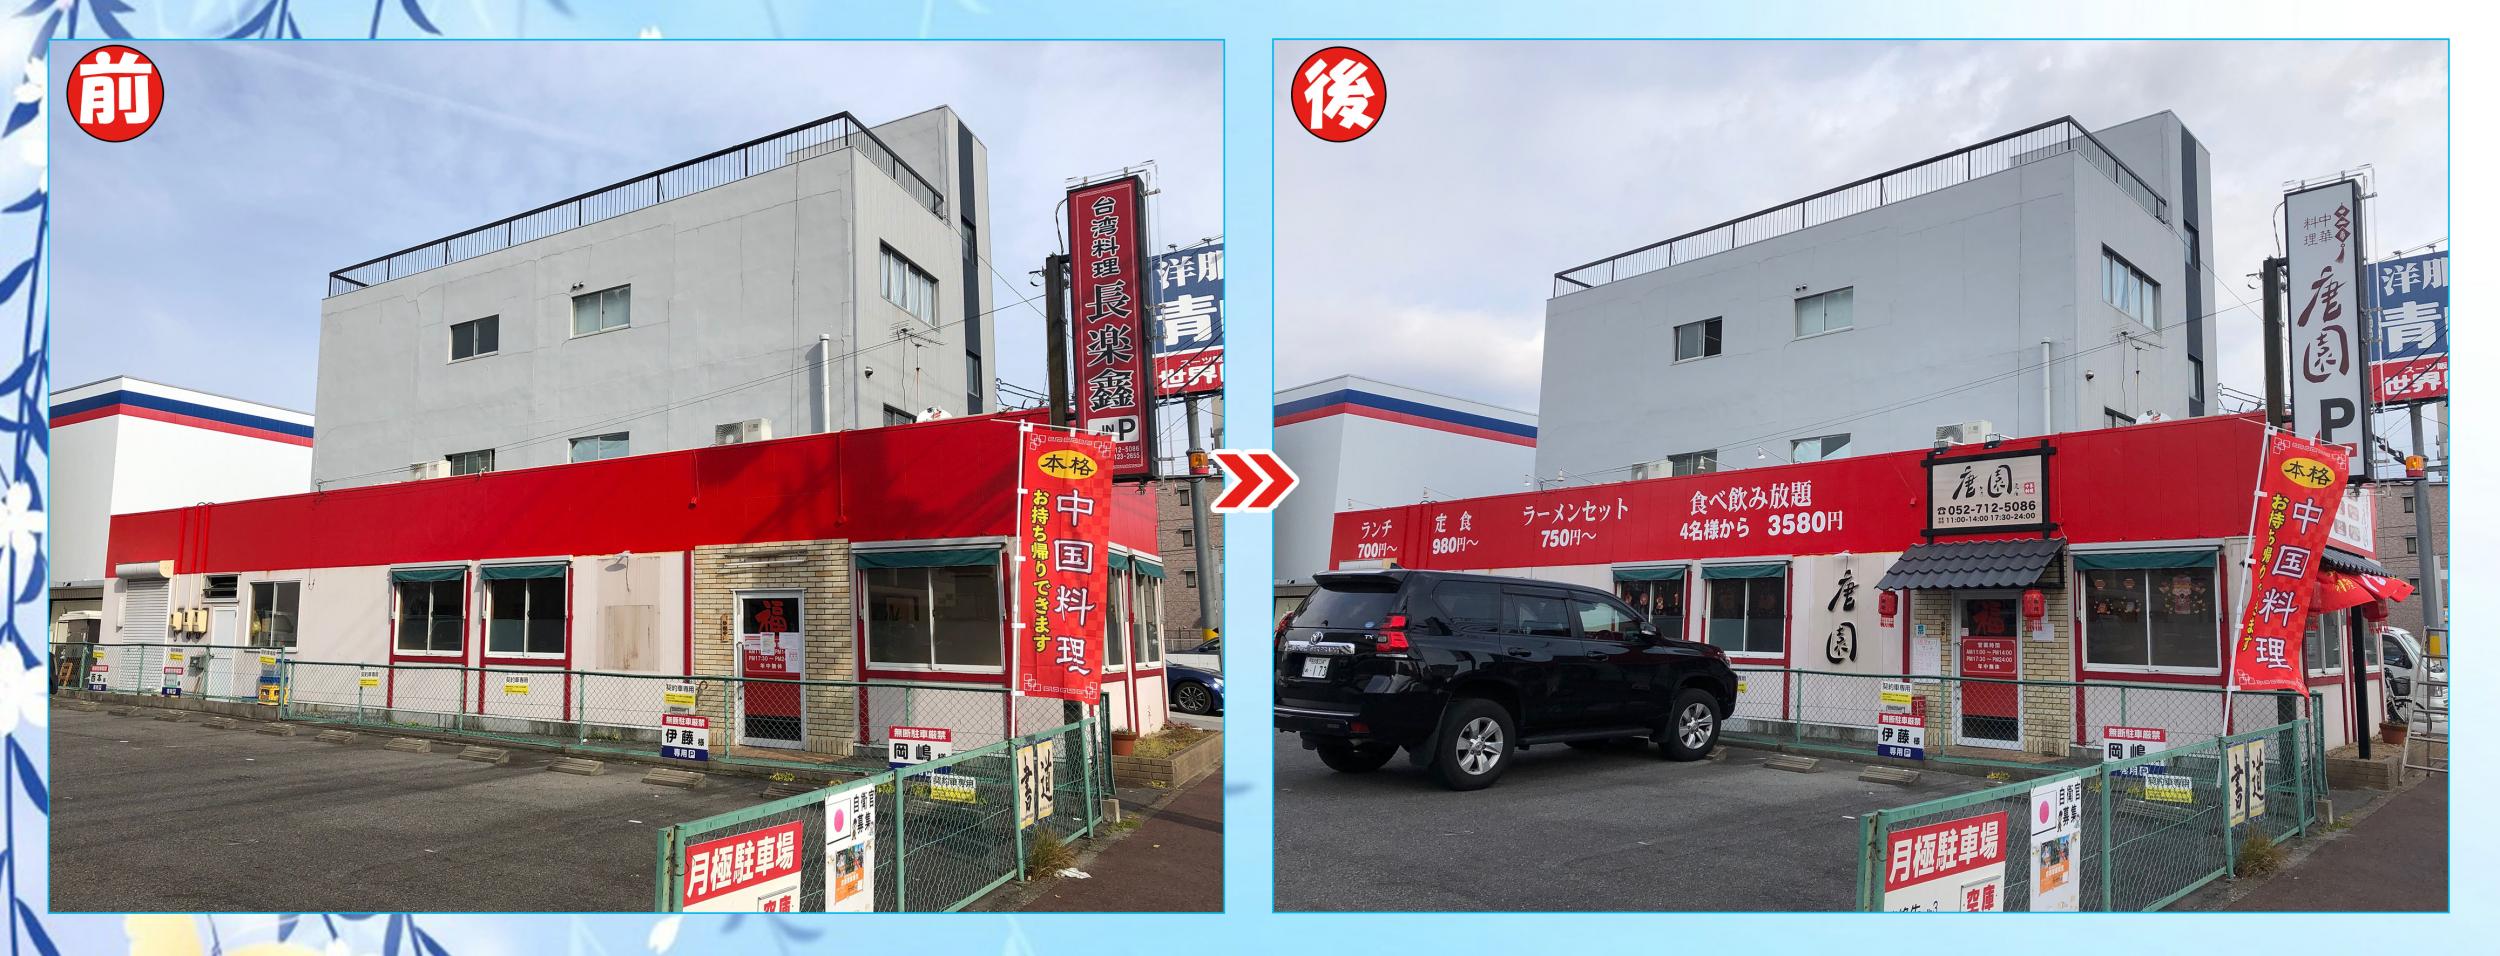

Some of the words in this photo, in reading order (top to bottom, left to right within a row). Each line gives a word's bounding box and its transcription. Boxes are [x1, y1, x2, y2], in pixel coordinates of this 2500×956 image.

[1090, 196, 1122, 279] 台湾料理
[2297, 265, 2350, 384] 唐園
[1084, 279, 1135, 413] 長楽鑫
[1102, 424, 1115, 434] IN
[1118, 418, 1136, 441] P
[2320, 397, 2356, 446] P
[1041, 454, 1095, 477] 本格
[2284, 460, 2332, 486] 本格
[1523, 497, 1629, 527] ラーメンセット
[1690, 480, 1812, 516] 食べ飲み放題
[1948, 500, 2036, 515] 052-712-5086
[1361, 519, 1393, 540] ランチ
[1680, 517, 1749, 541] 4名様から
[1767, 510, 1843, 536] 3580円
[1031, 489, 1051, 653] お持ち帰りできます
[1053, 489, 1096, 676] 中国料理
[2255, 498, 2324, 671] 中国料理
[755, 600, 787, 632] 福
[666, 729, 694, 745] 伊藤
[1882, 727, 1910, 744] 伊藤
[687, 831, 795, 899] 月極駐車場
[1889, 821, 1999, 884] 月極駐車場
